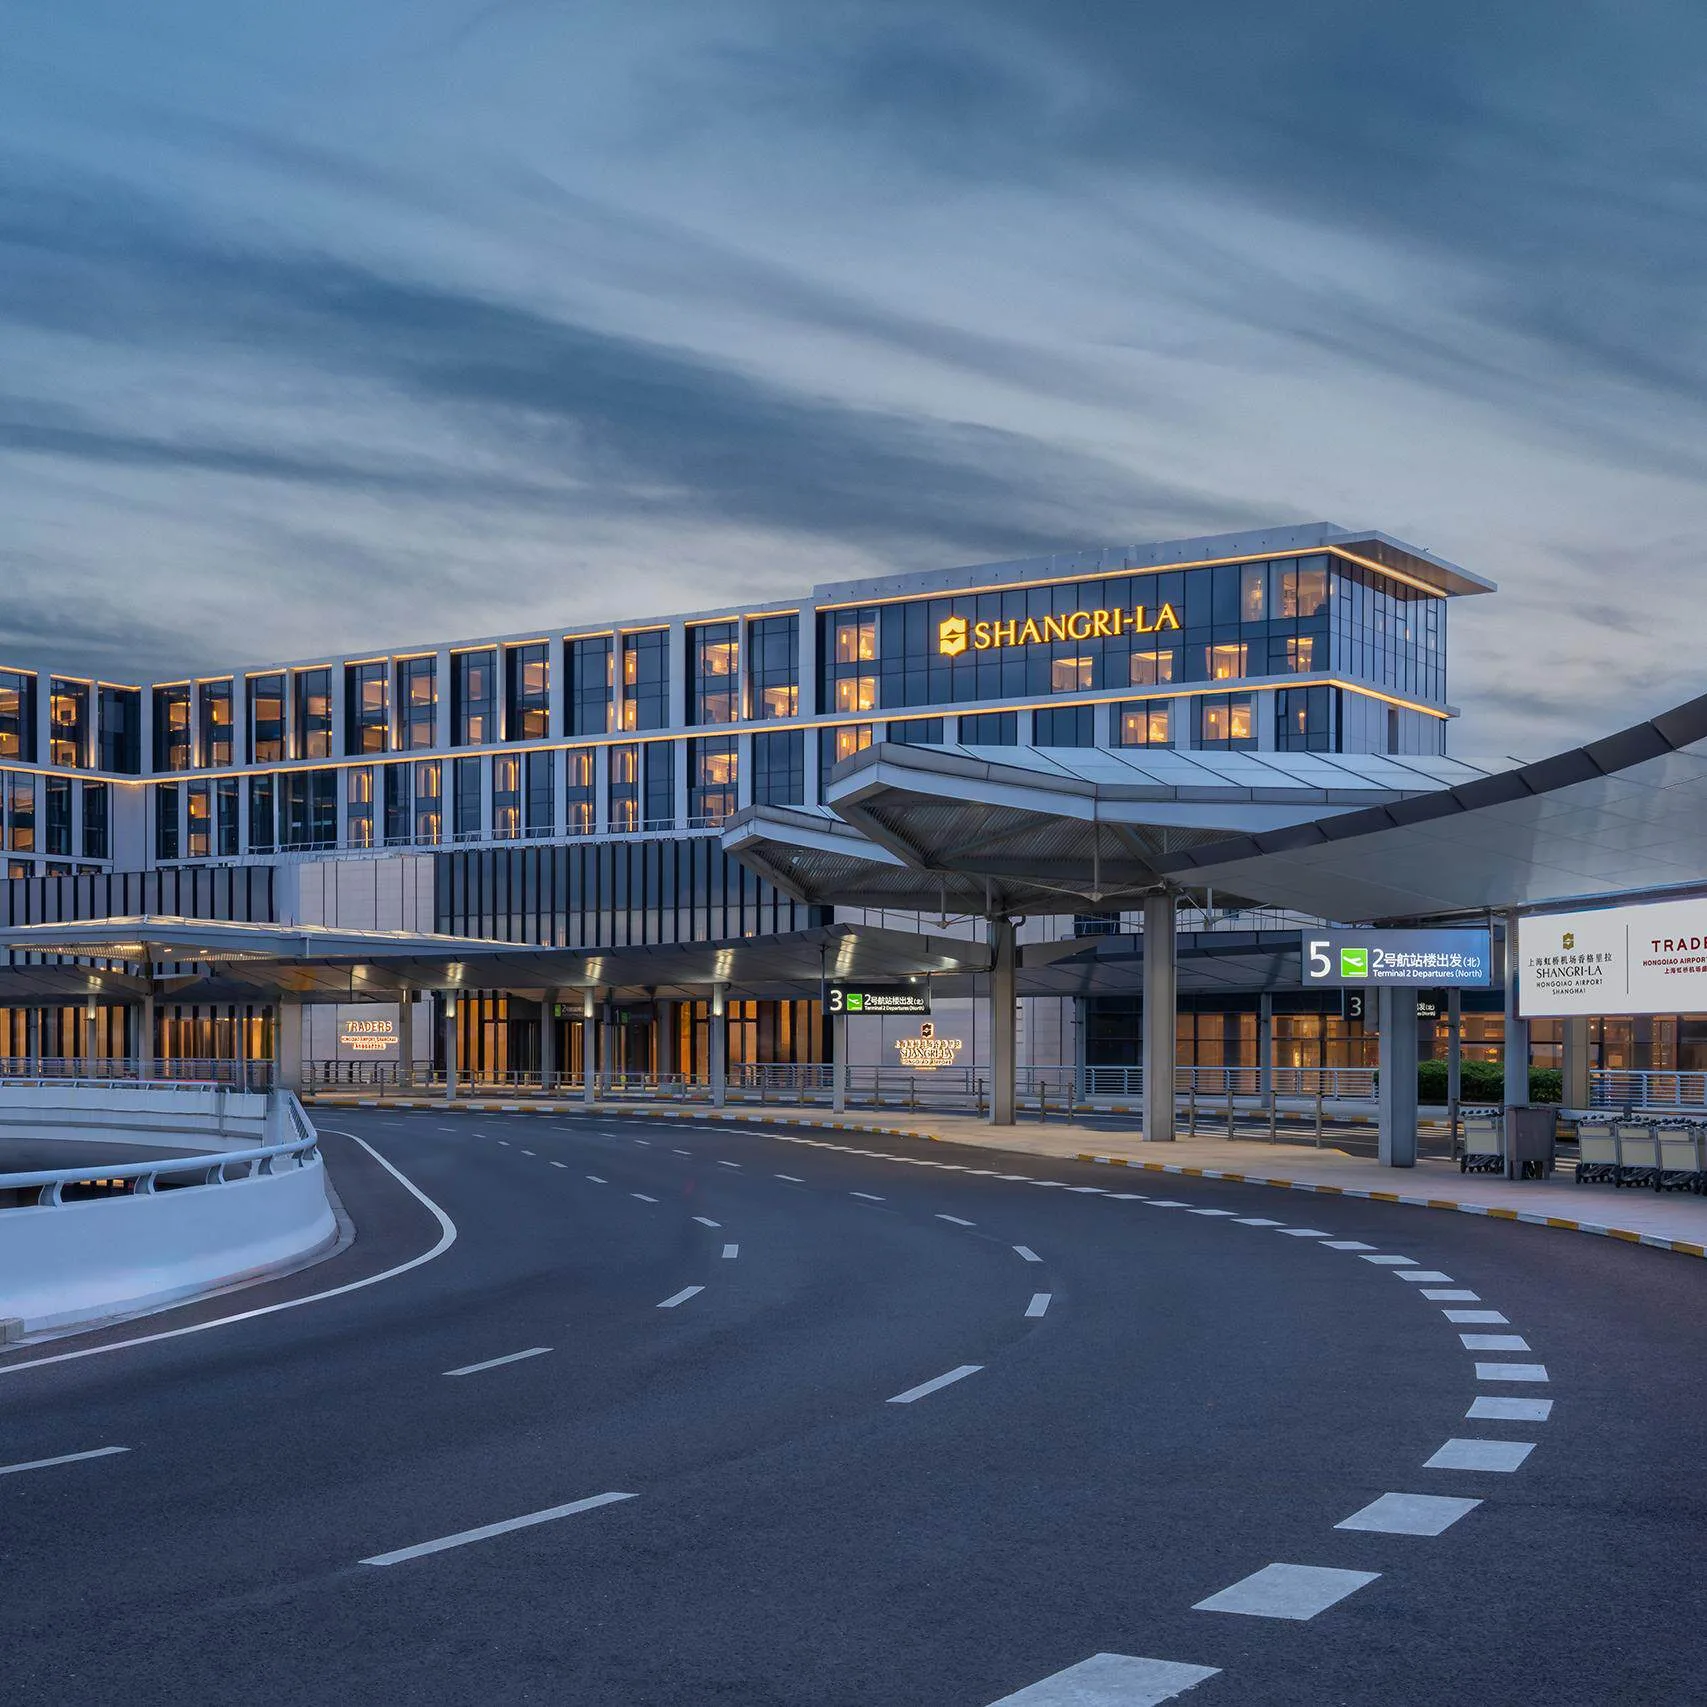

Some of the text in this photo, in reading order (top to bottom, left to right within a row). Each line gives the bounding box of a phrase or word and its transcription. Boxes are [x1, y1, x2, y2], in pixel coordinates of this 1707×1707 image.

[974, 603, 1181, 650] SHANGRI-LA
[1310, 941, 1331, 978] 5
[1528, 952, 1613, 968] 上海虹桥机场香格里拉
[1643, 956, 1707, 967] HONGQIAO AIRPOR
[1373, 969, 1483, 979] Terminal 2 Departures (North)
[1536, 965, 1603, 979] SHANGRI-LA
[1536, 978, 1603, 988] HONGQIAO AIRPORT
[1552, 987, 1586, 996] SHANGHAI
[829, 989, 843, 1011] 3
[1350, 996, 1362, 1017] 3
[345, 1020, 393, 1033] TRADERS
